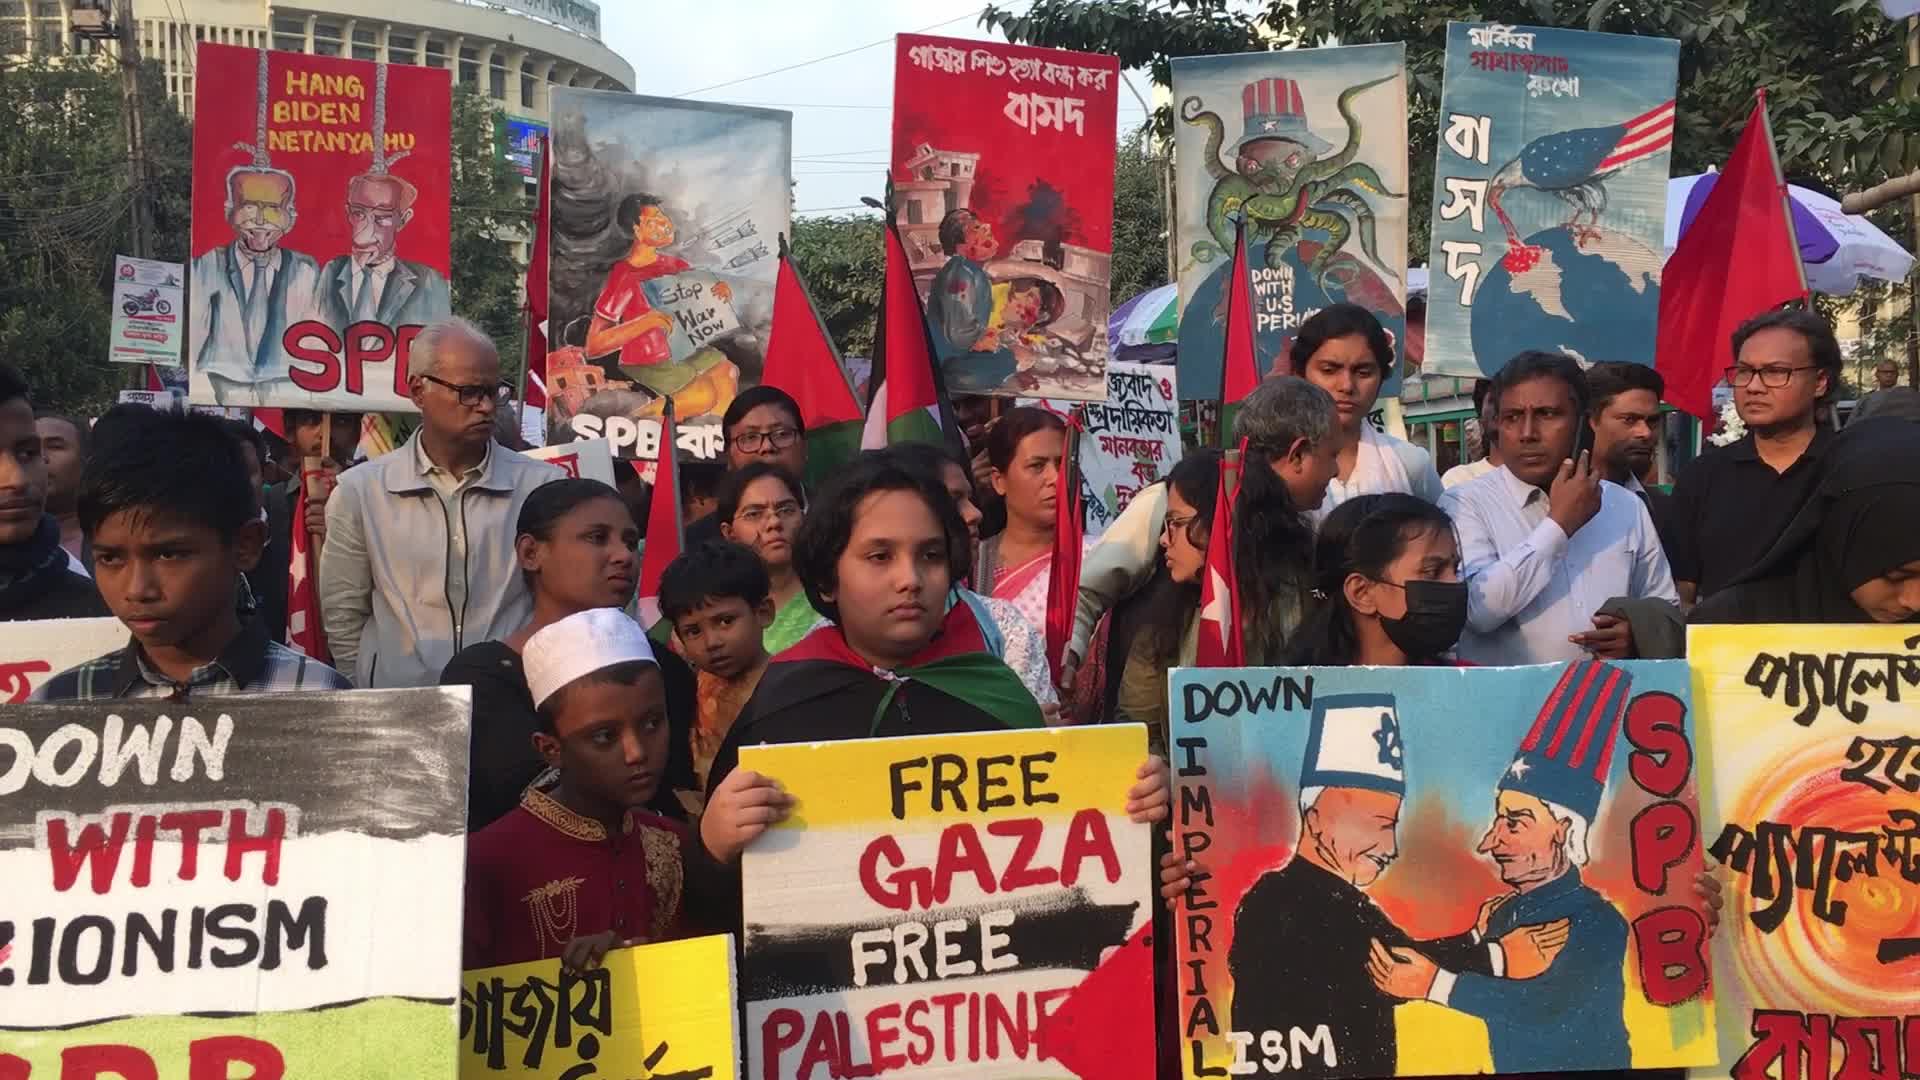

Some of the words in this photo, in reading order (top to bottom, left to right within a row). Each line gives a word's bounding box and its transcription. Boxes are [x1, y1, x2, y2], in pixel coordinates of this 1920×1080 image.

[286, 70, 365, 100] HANG
[1077, 66, 1113, 91] কর
[273, 100, 361, 125] BIDEN
[1251, 265, 1293, 284] DOWN
[1253, 280, 1294, 297] WITH
[1182, 675, 1314, 724] DOWN
[888, 751, 1061, 820] FREE
[46, 806, 288, 896] WITH
[858, 808, 1123, 911] GAZA
[0, 895, 329, 986] IONISM
[849, 909, 1020, 987] FREE
